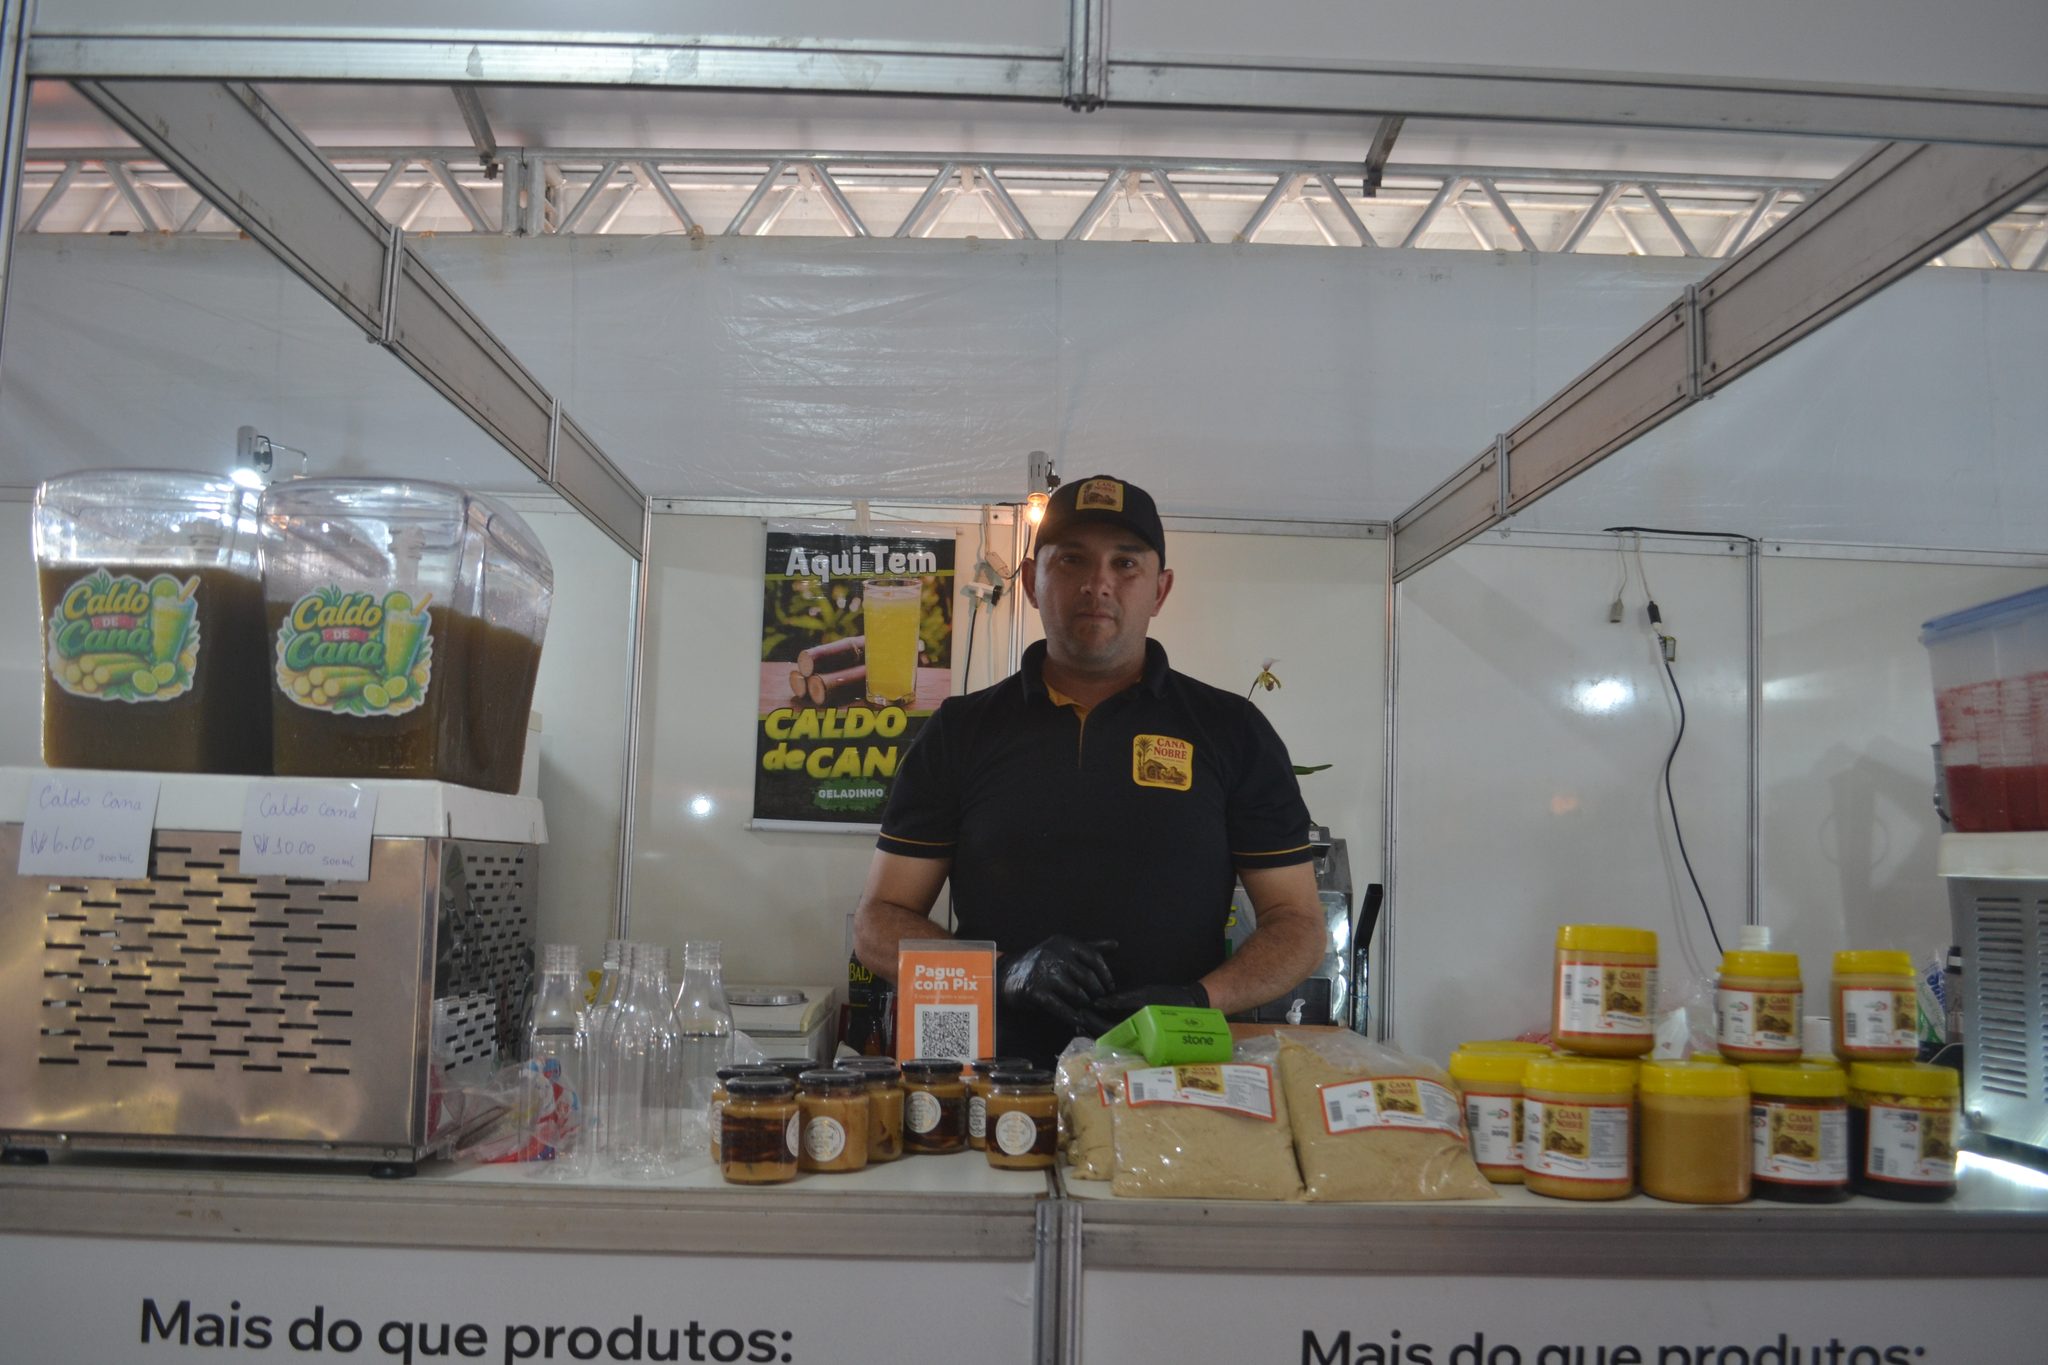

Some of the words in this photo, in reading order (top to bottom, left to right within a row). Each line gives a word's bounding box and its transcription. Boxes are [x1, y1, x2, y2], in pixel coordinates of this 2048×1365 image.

[785, 546, 861, 583] Aqui
[869, 545, 937, 574] Tem
[64, 582, 149, 619] Caldo
[293, 595, 382, 631] Caldo
[101, 617, 119, 627] DE
[332, 629, 350, 640] DE
[58, 620, 152, 658] Cana
[287, 631, 384, 671] Cana
[764, 706, 908, 740] CALDO
[1153, 747, 1188, 760] NOBRE
[1156, 737, 1186, 750] CANA
[762, 742, 807, 771] de
[805, 745, 903, 779] CAN
[39, 784, 90, 810] Caldo
[260, 791, 309, 819] Caldo
[818, 787, 885, 799] GELADINHO
[914, 964, 966, 980] Pague
[914, 979, 949, 991] com
[953, 977, 978, 991] Pix
[1182, 1033, 1214, 1046] stone
[141, 1298, 272, 1350] Mais
[288, 1305, 363, 1354] do
[378, 1320, 488, 1365] que
[504, 1314, 793, 1365] produtos:
[1302, 1329, 1433, 1365] Mais
[1448, 1332, 1521, 1365] do
